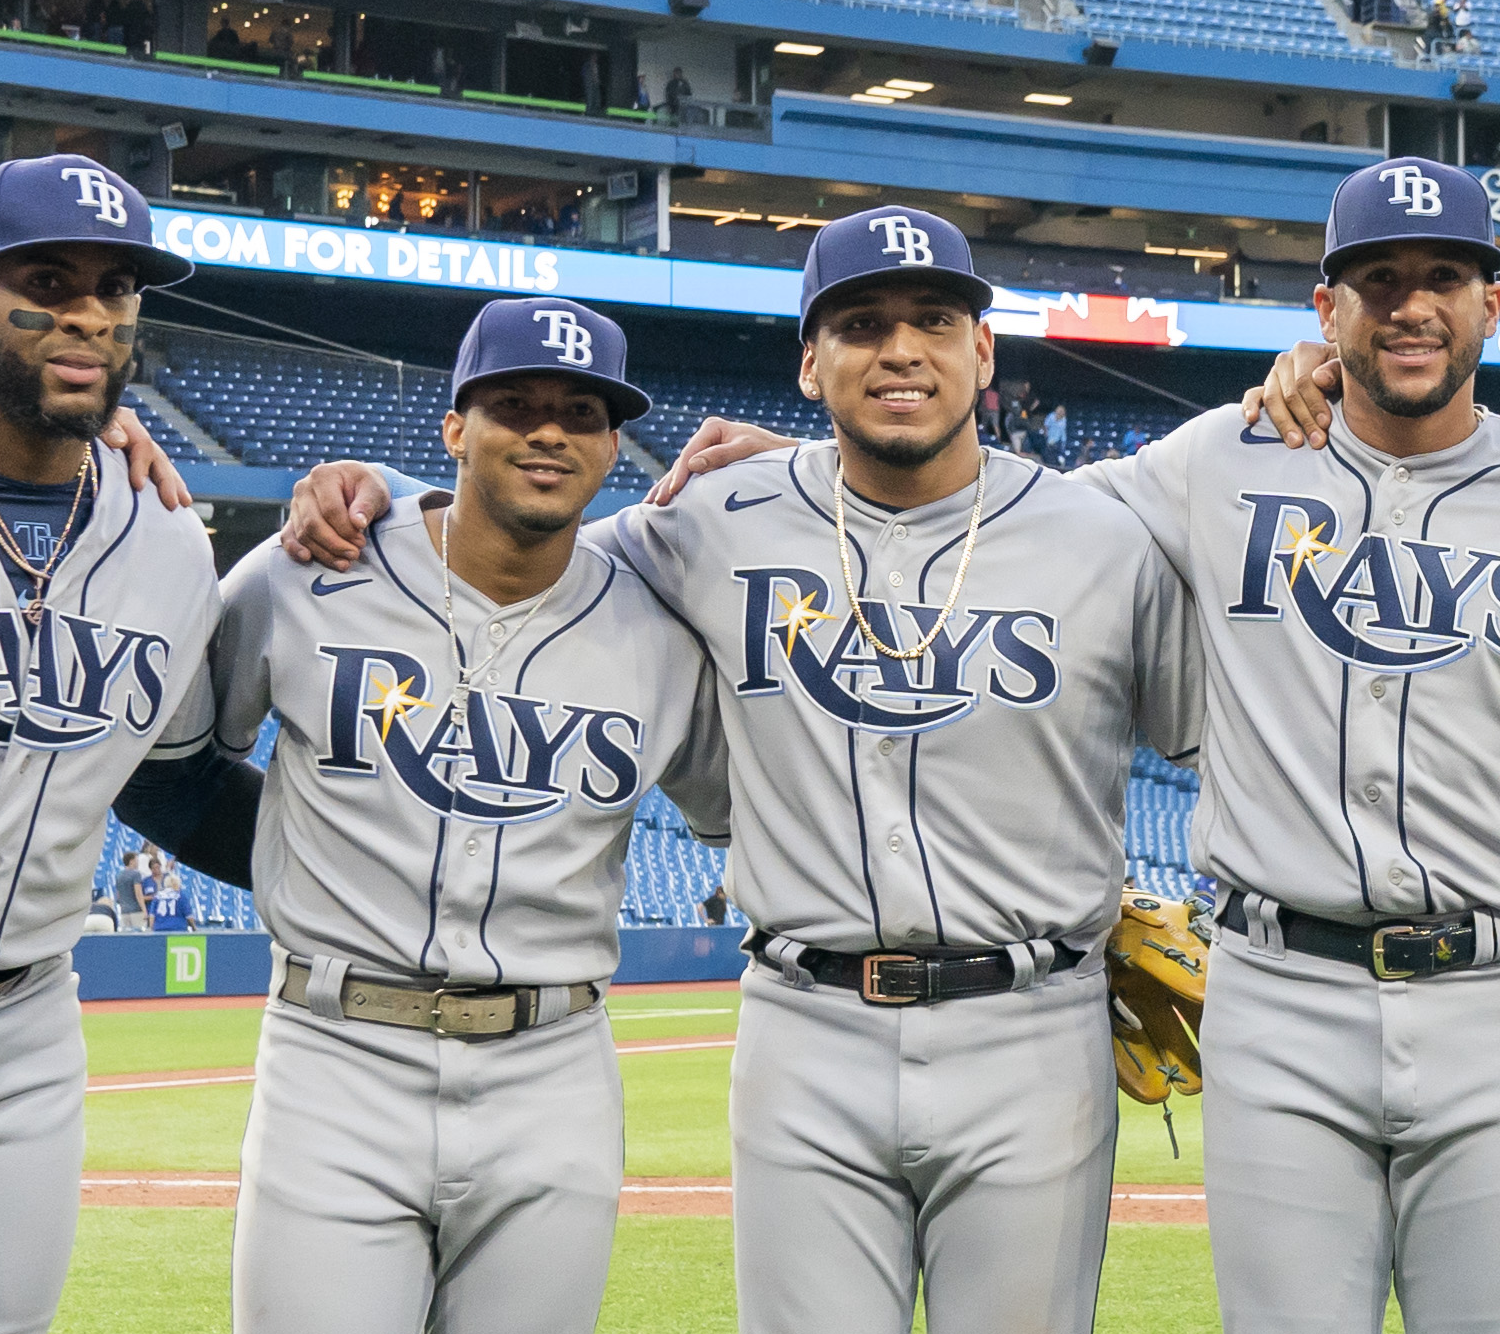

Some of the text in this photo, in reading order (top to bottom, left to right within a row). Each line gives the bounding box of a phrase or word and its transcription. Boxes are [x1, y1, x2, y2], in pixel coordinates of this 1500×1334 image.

[60, 167, 128, 228] TB
[1378, 164, 1443, 218] TB
[284, 227, 374, 274] FOR
[387, 236, 559, 292] DETAILS
[867, 214, 934, 268] TB
[532, 308, 593, 368] TB
[732, 565, 1059, 734] RAYS
[316, 643, 644, 824] RAYS
[170, 946, 201, 982] TD
